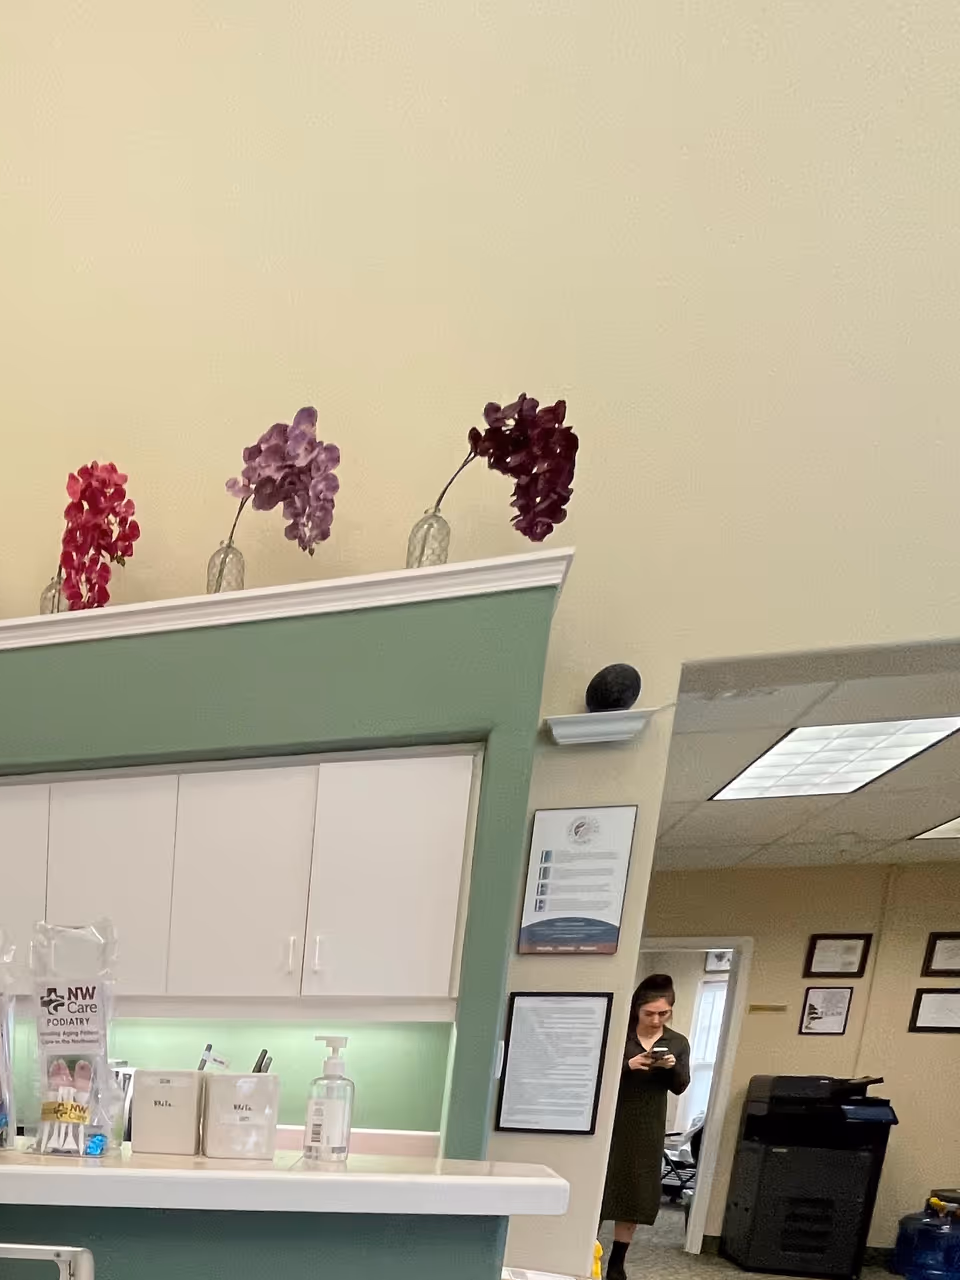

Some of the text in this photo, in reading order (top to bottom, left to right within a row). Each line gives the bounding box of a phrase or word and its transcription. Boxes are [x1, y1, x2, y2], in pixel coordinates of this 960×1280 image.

[67, 986, 96, 1001] NW
[67, 1001, 98, 1014] Care
[46, 1017, 90, 1027] PODIATRY
[70, 1104, 88, 1114] NW
